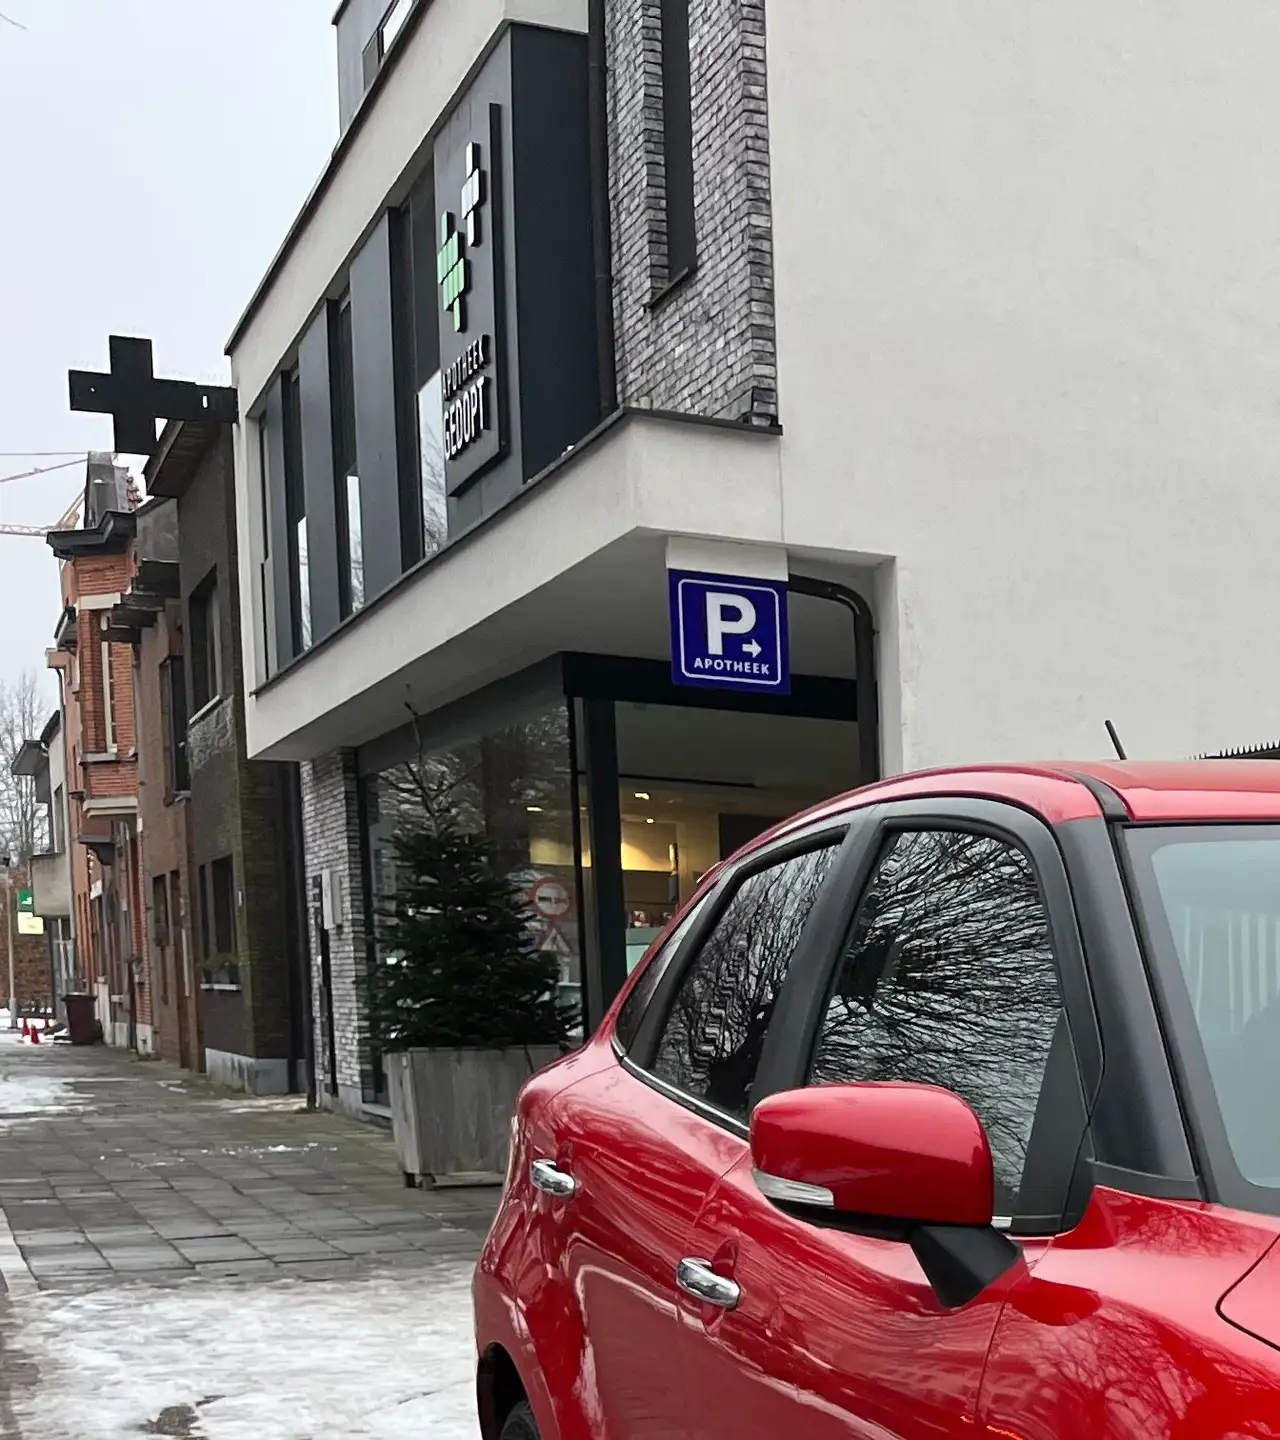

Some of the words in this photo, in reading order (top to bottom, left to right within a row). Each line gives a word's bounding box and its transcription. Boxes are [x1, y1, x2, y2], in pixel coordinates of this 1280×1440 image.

[444, 376, 485, 460] GEDOPT
[705, 591, 757, 656] P
[693, 657, 770, 675] APOTHEEK
